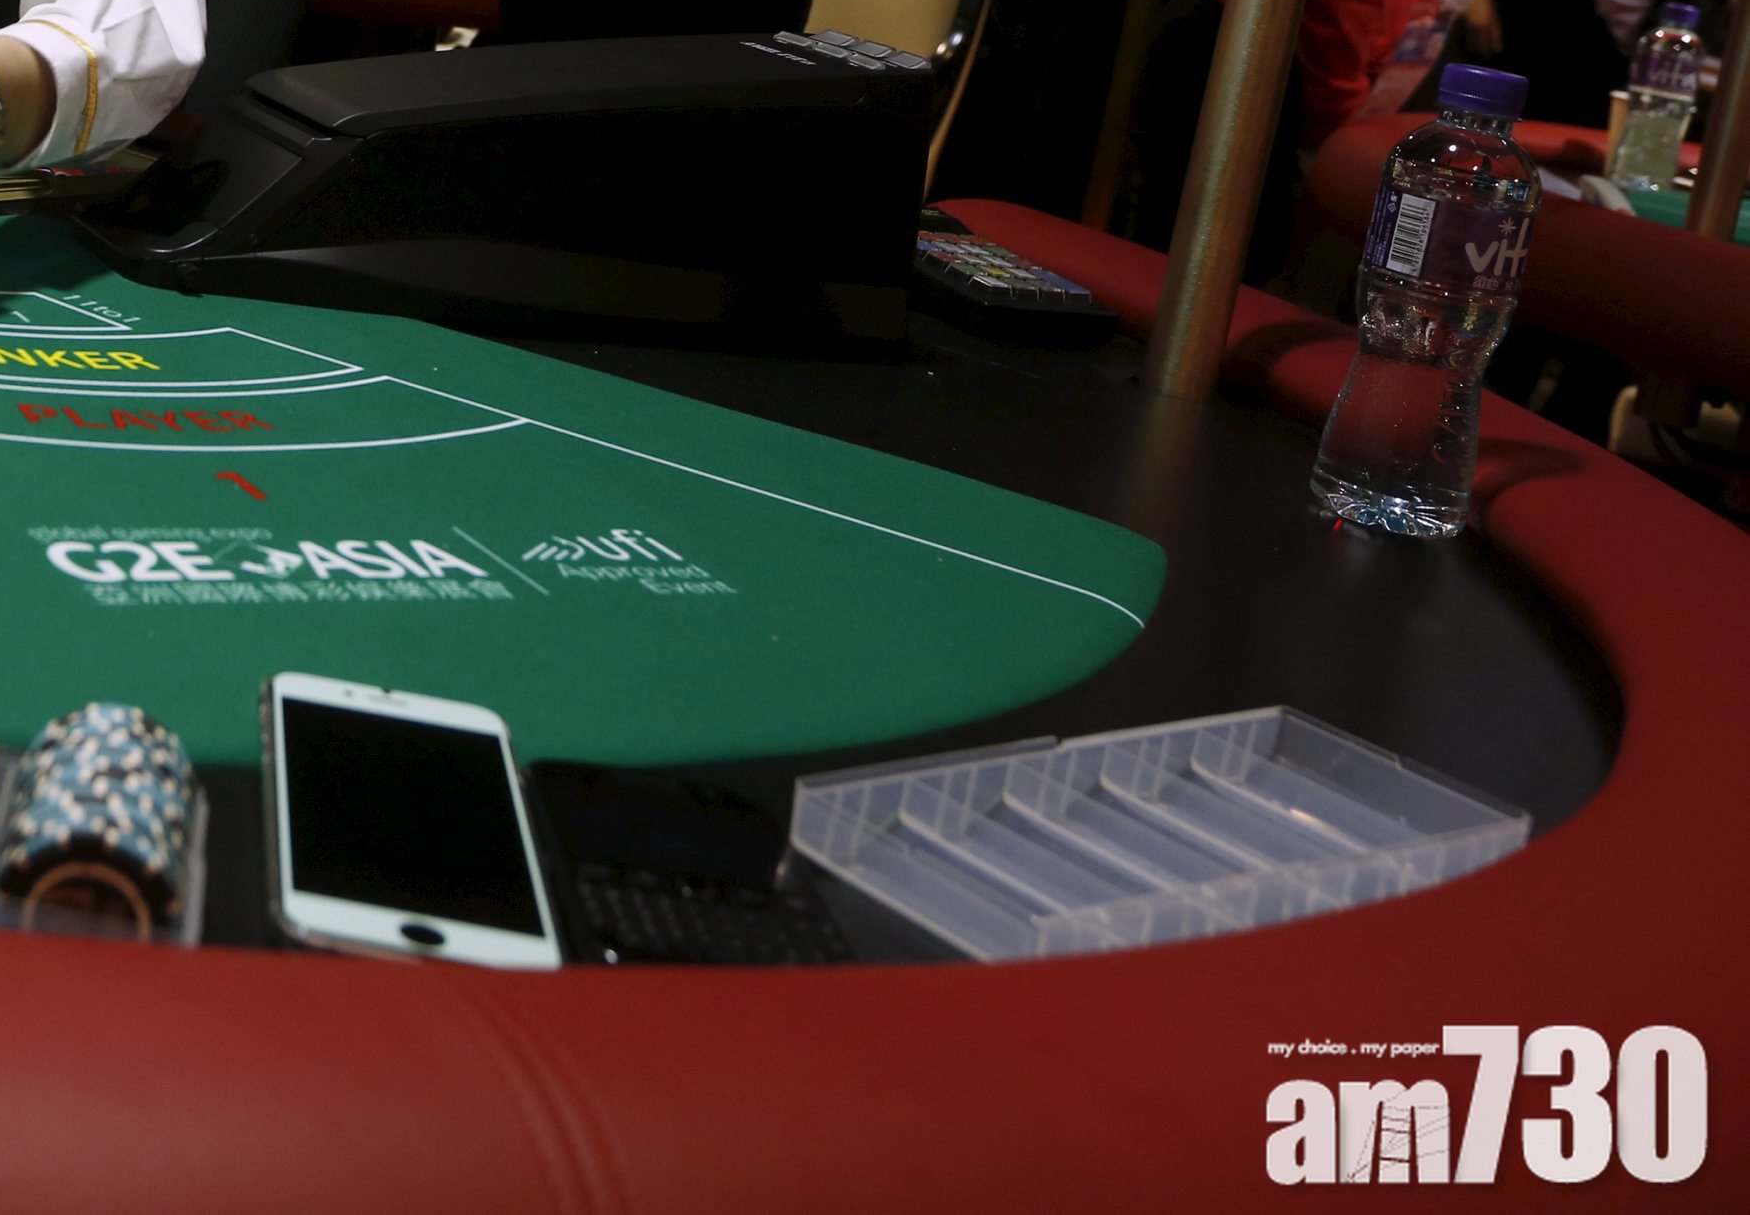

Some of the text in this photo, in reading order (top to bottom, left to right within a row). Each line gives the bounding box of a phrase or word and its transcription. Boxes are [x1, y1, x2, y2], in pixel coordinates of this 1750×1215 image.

[17, 402, 275, 433] PLAYER
[214, 470, 269, 502] 1
[46, 538, 489, 584] G2E ASIA
[576, 528, 685, 563] ufi
[556, 562, 712, 582] Approved
[639, 577, 739, 594] Event
